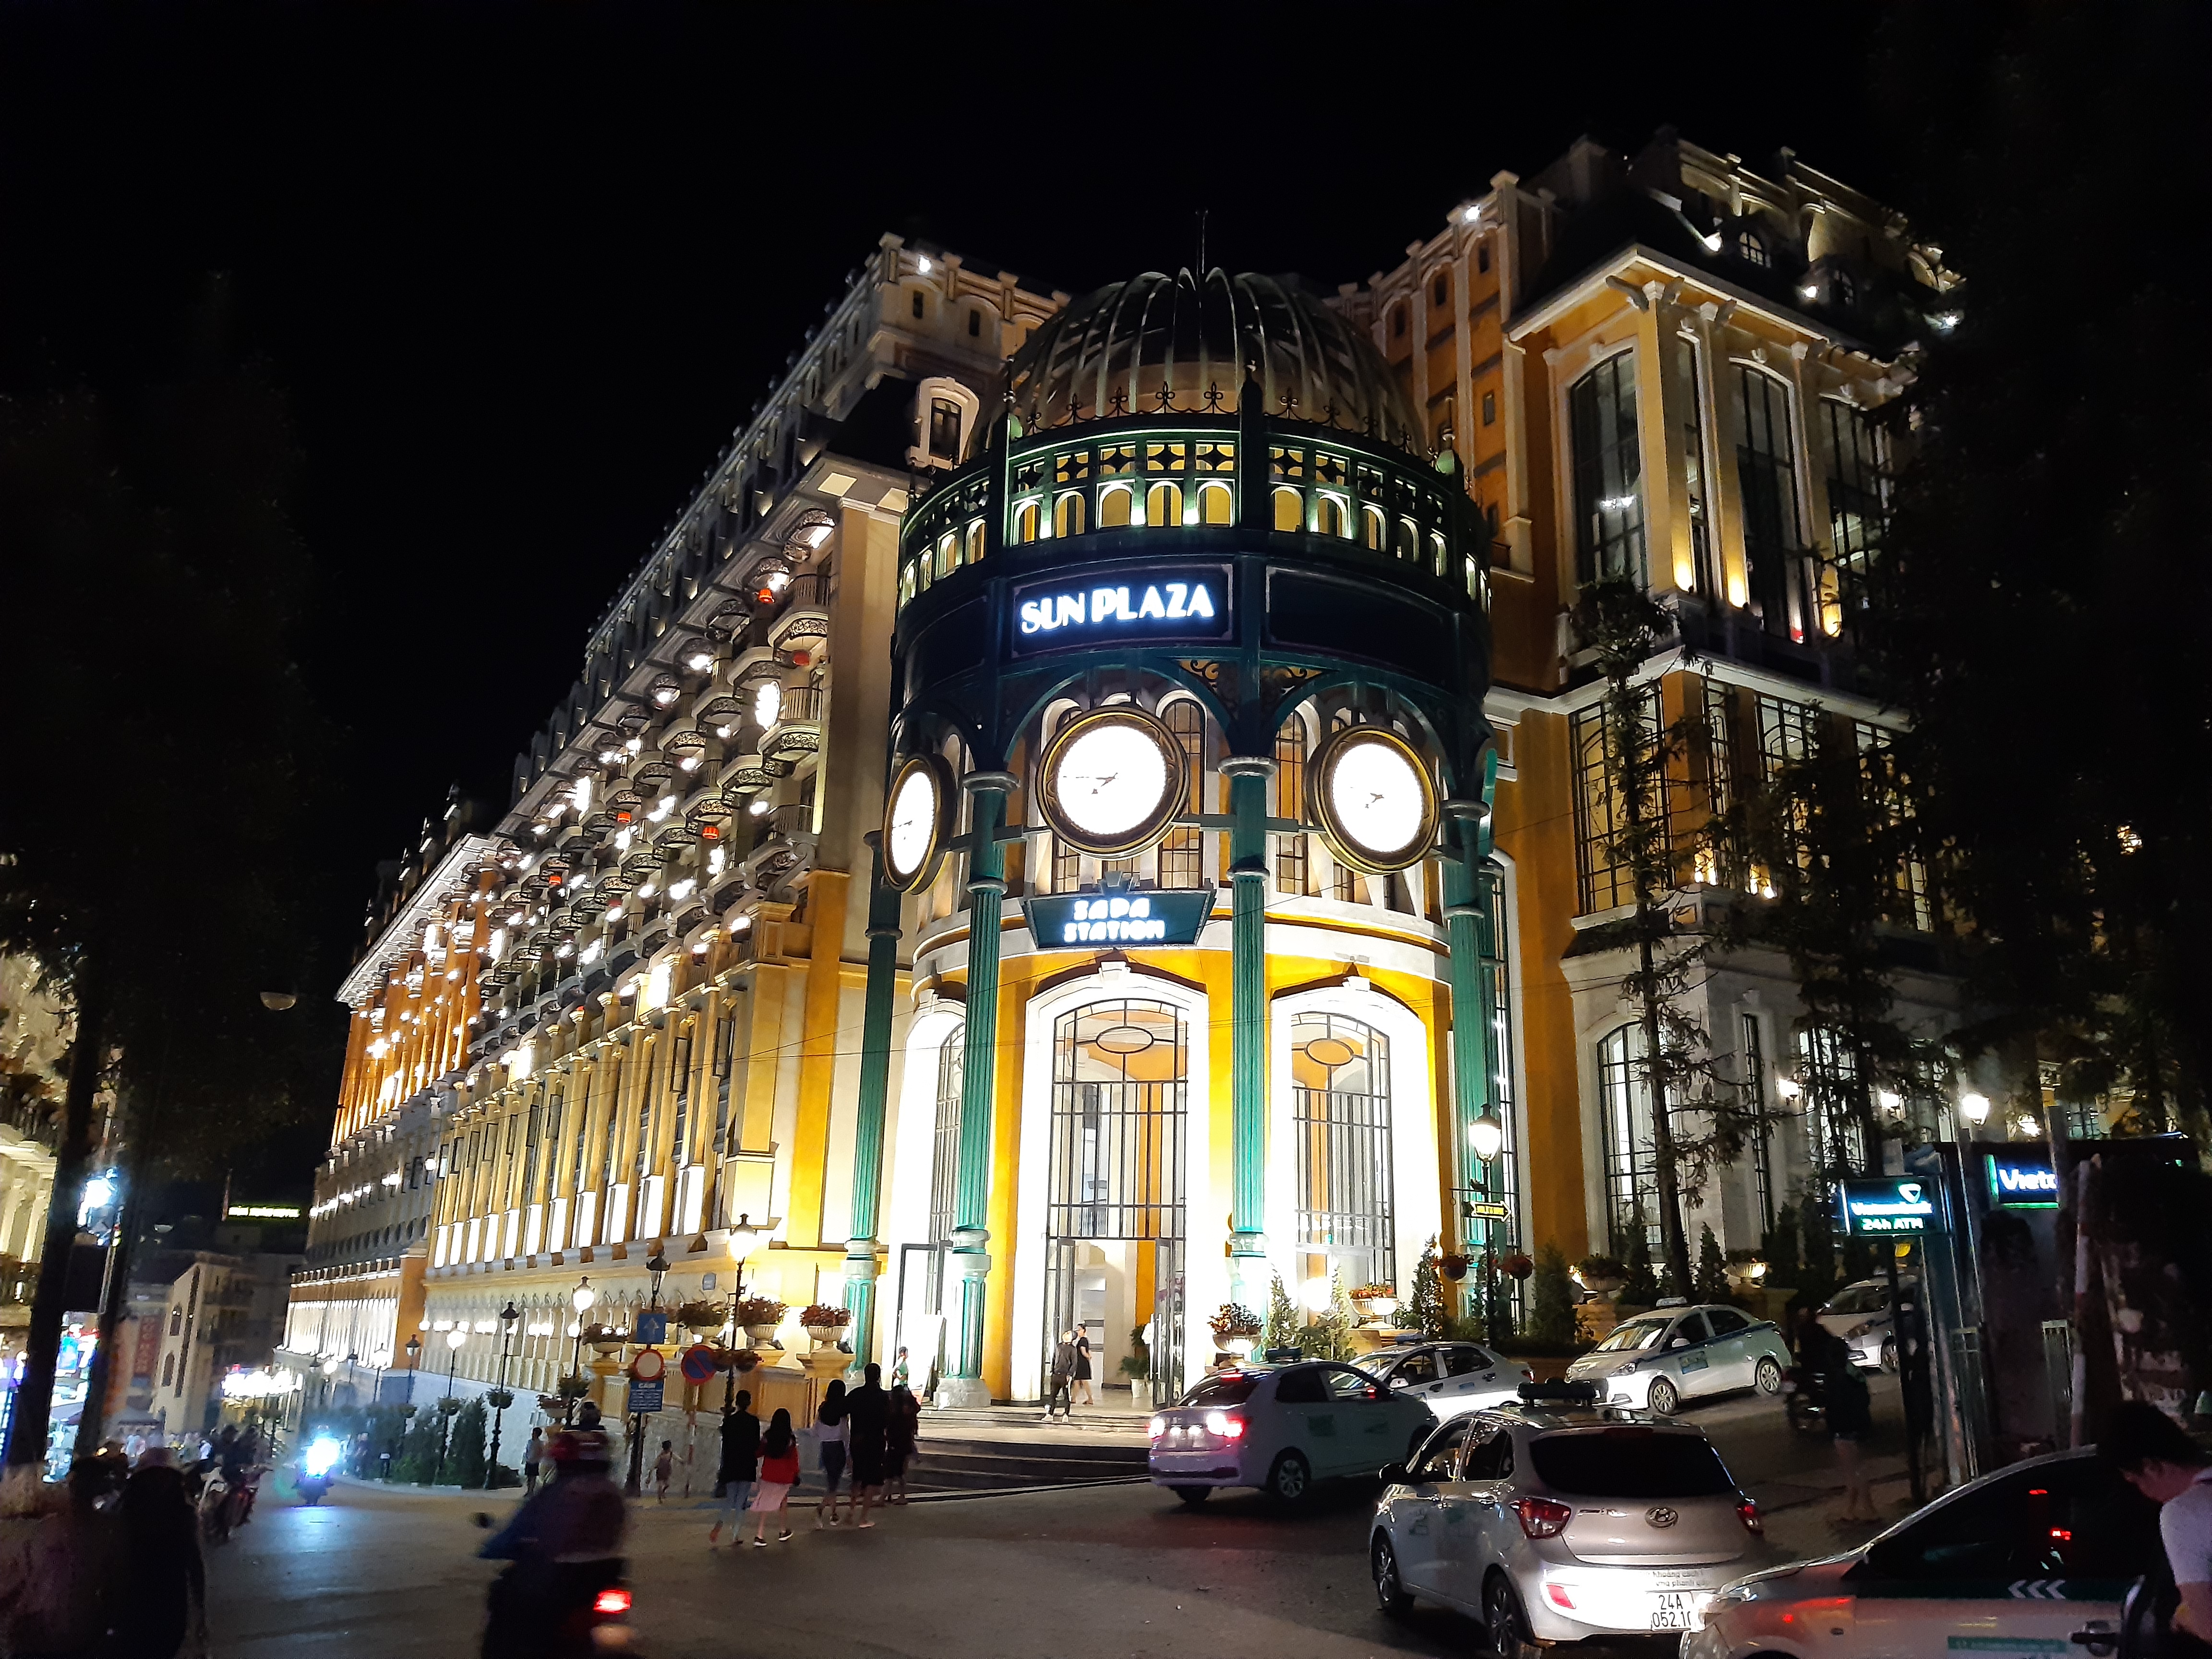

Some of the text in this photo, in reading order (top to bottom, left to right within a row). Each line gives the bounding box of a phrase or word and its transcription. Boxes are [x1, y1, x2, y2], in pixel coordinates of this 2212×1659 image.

[1021, 583, 1214, 634] SUN PLAZA
[1074, 898, 1149, 920] SAPA
[1064, 920, 1165, 942] STATION
[1862, 1217, 1924, 1230] 24h ATM
[1658, 1594, 1683, 1610] 24A
